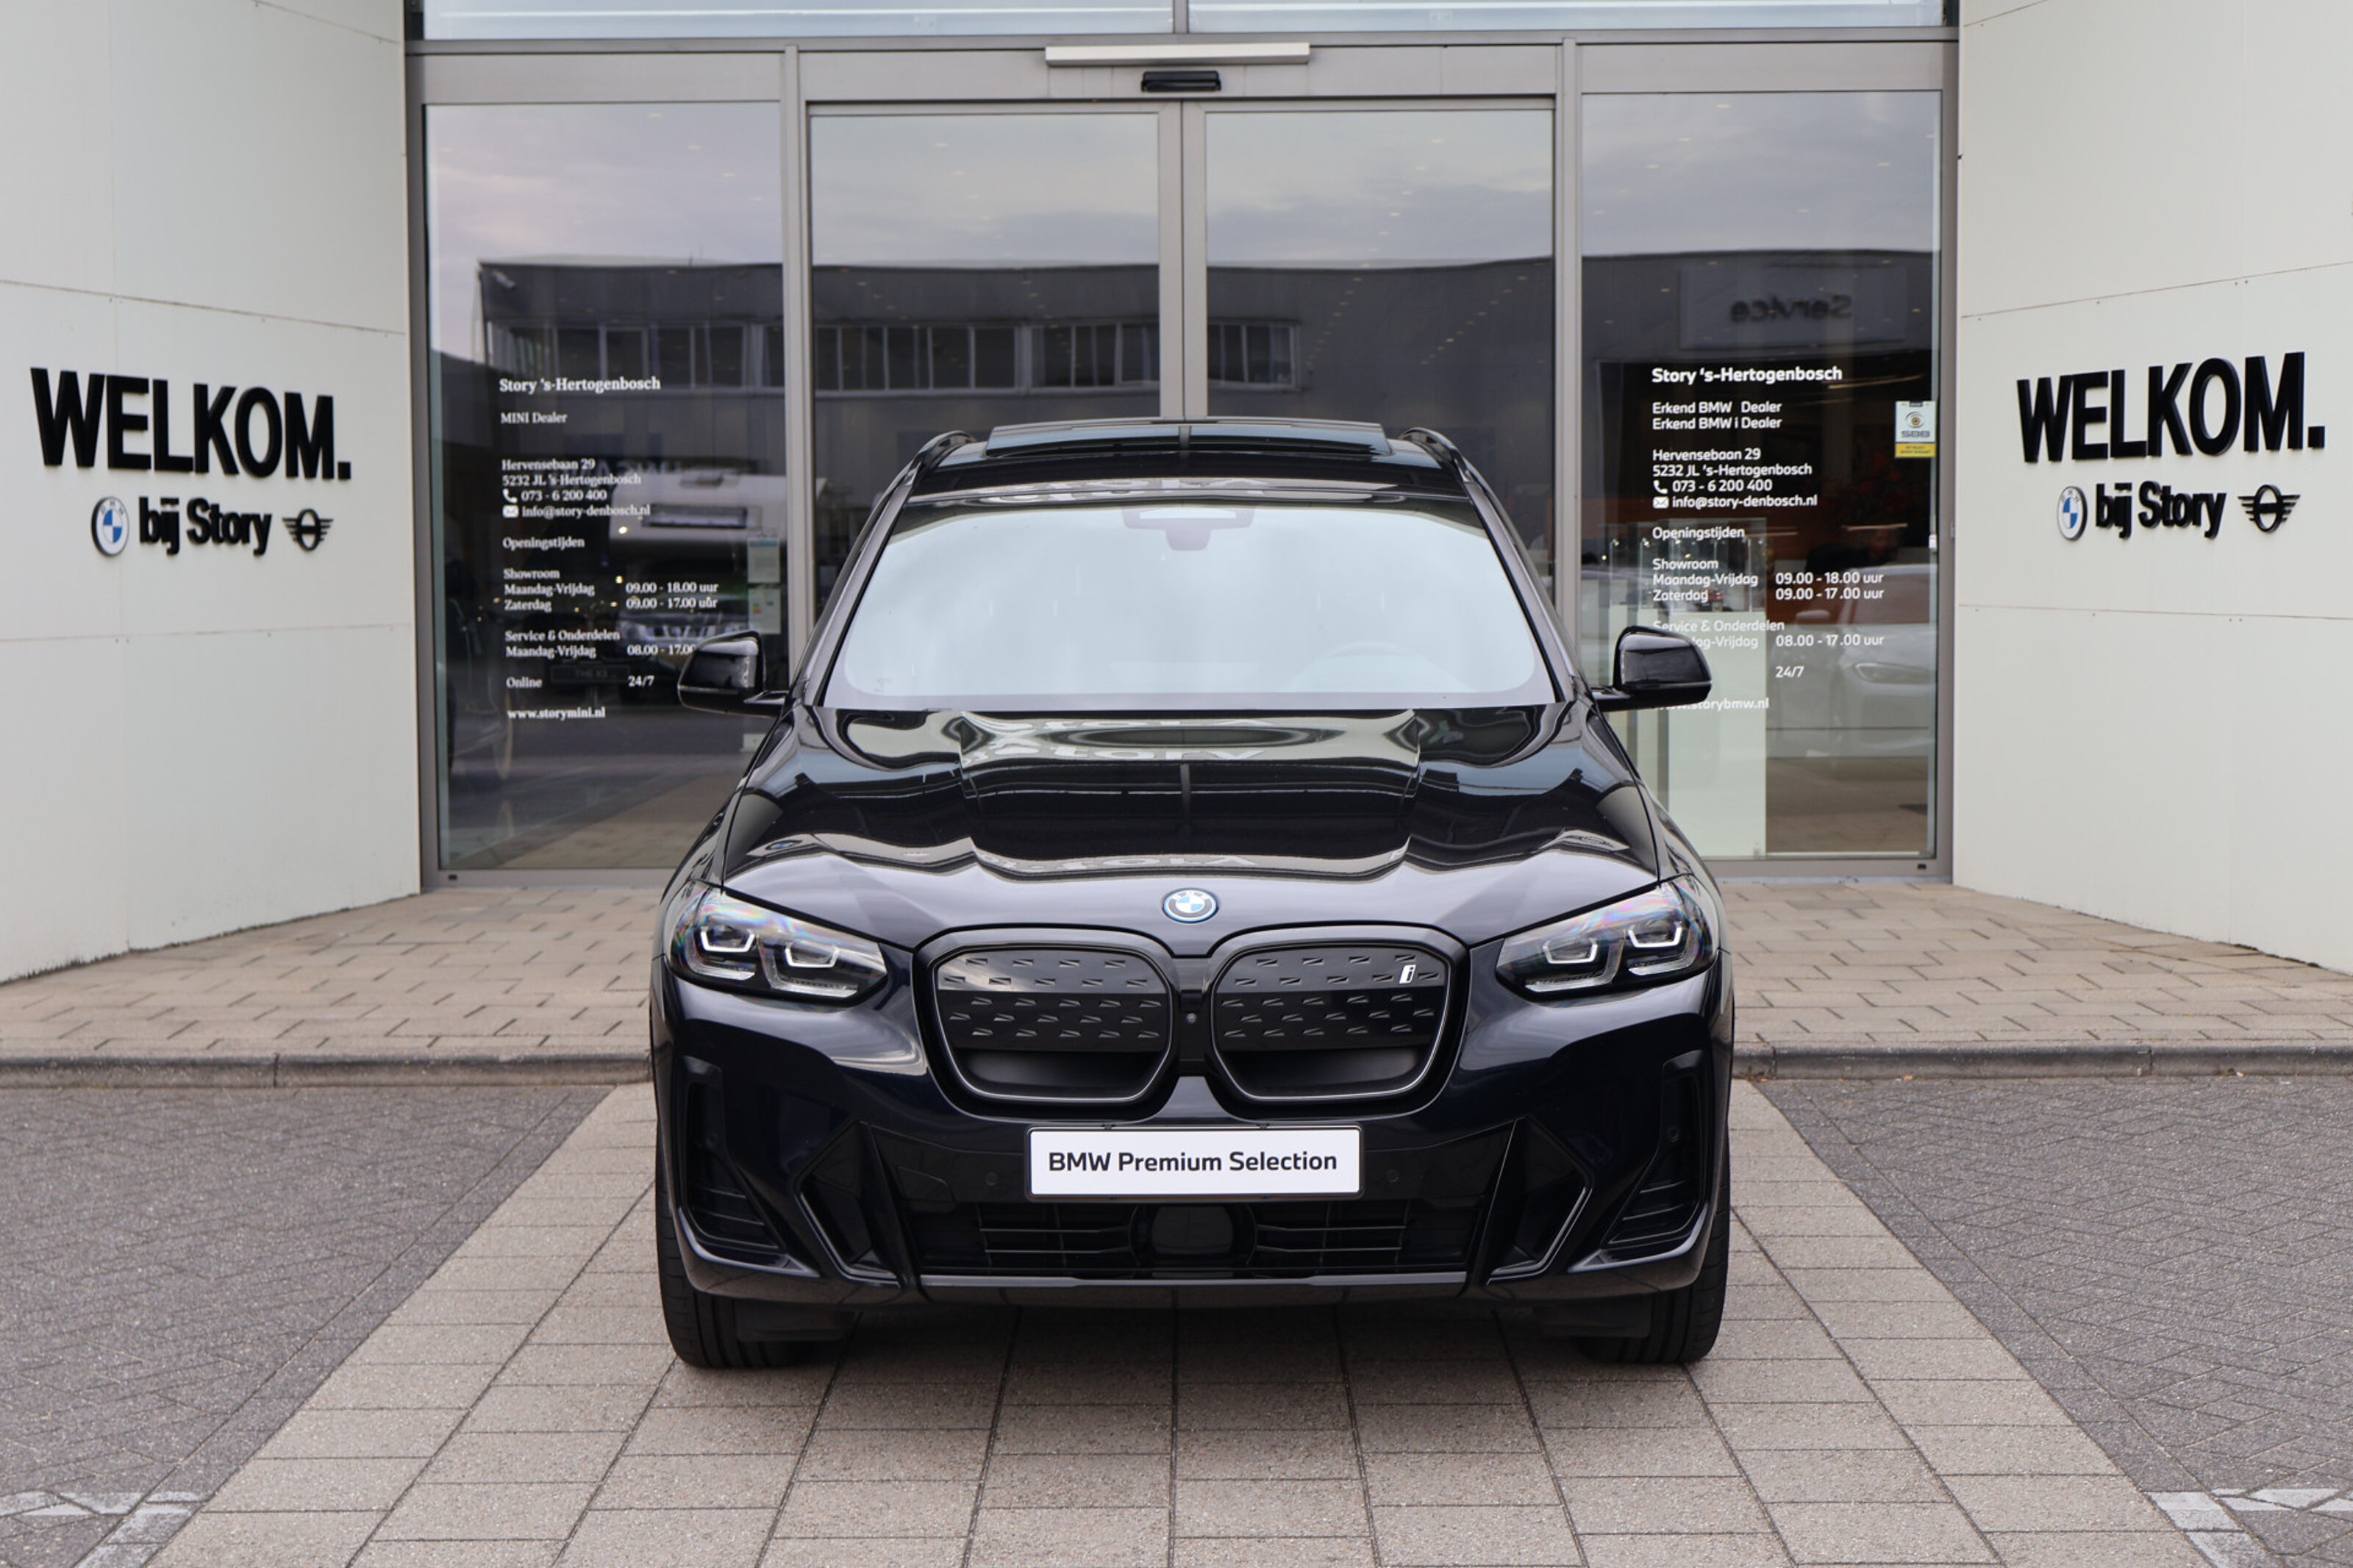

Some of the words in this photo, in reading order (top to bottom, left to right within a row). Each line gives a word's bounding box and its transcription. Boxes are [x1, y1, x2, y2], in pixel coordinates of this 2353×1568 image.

[1652, 368, 1696, 385] Story
[499, 378, 537, 395] Story
[1652, 402, 1696, 415] Erkend
[1699, 401, 1732, 414] BMW
[1741, 401, 1782, 413] Dealer
[2016, 351, 2325, 462] WELKOM.
[30, 367, 351, 480] WELKOM.
[501, 412, 530, 424] MINI
[532, 412, 568, 424] Dealer
[1652, 418, 1696, 430] Erkend
[1699, 417, 1732, 429] BMW
[1734, 417, 1739, 429] i
[1741, 416, 1782, 429] Dealer
[1652, 449, 1742, 462] Hervensebaan
[1744, 448, 1761, 460] 29
[501, 459, 579, 471] Hervensebaan
[581, 458, 596, 470] 29
[1652, 465, 1684, 477] 5232
[1685, 464, 1700, 478] JL
[501, 475, 531, 487] 5232
[532, 475, 547, 487] JL
[1672, 480, 1696, 493] 073
[1707, 479, 1716, 492] 6
[1718, 479, 1745, 492] 200
[1746, 479, 1773, 491] 400
[521, 490, 543, 502] 073
[551, 490, 560, 502] 6
[561, 490, 584, 501] 200
[585, 489, 607, 501] 400
[1672, 495, 1818, 509] info@story-denbosch.nl
[521, 504, 651, 519] info@story-denbosch.nl
[2096, 482, 2132, 538] bij
[2138, 481, 2227, 539] Story
[139, 496, 180, 556] bij
[186, 497, 272, 556] Story
[1652, 526, 1746, 541] Openingstijden
[502, 537, 585, 551] Openingstijden
[1652, 558, 1718, 570] Showroom
[503, 568, 560, 580] Showroom
[1653, 573, 1758, 587] Maandag-Vrijdag
[1775, 573, 1813, 584] 09.00
[1825, 571, 1860, 584] 18.00
[1863, 573, 1884, 584] uur
[504, 583, 595, 597] Maandag-Vrijdag
[625, 582, 657, 594] 09.00
[666, 581, 697, 593] 18.00
[699, 584, 718, 593] uur
[1653, 590, 1709, 603] Zaterdag
[1775, 588, 1813, 600] 09.00
[1863, 590, 1884, 600] uur
[504, 598, 551, 612] Zaterdag
[625, 598, 657, 609] 09.00
[668, 597, 697, 609] 17.00
[699, 599, 718, 609] uur
[1701, 620, 1710, 631] &
[1714, 619, 1785, 631] Onderdelen
[504, 630, 546, 642] Service
[547, 630, 557, 642] &
[557, 629, 620, 641] Onderdelen
[1775, 635, 1814, 647] 08.00
[1863, 636, 1884, 646] uur
[506, 645, 596, 659] Maandag-Vrijdag
[626, 644, 659, 656] 08.00
[1775, 665, 1804, 679] 24/7
[506, 676, 543, 689] Online
[628, 675, 654, 688] 24/7
[507, 706, 606, 720] www.storymini.nl
[1049, 1152, 1111, 1172] BMW
[1118, 1152, 1222, 1172] Premium
[1229, 1150, 1338, 1171] Selection
